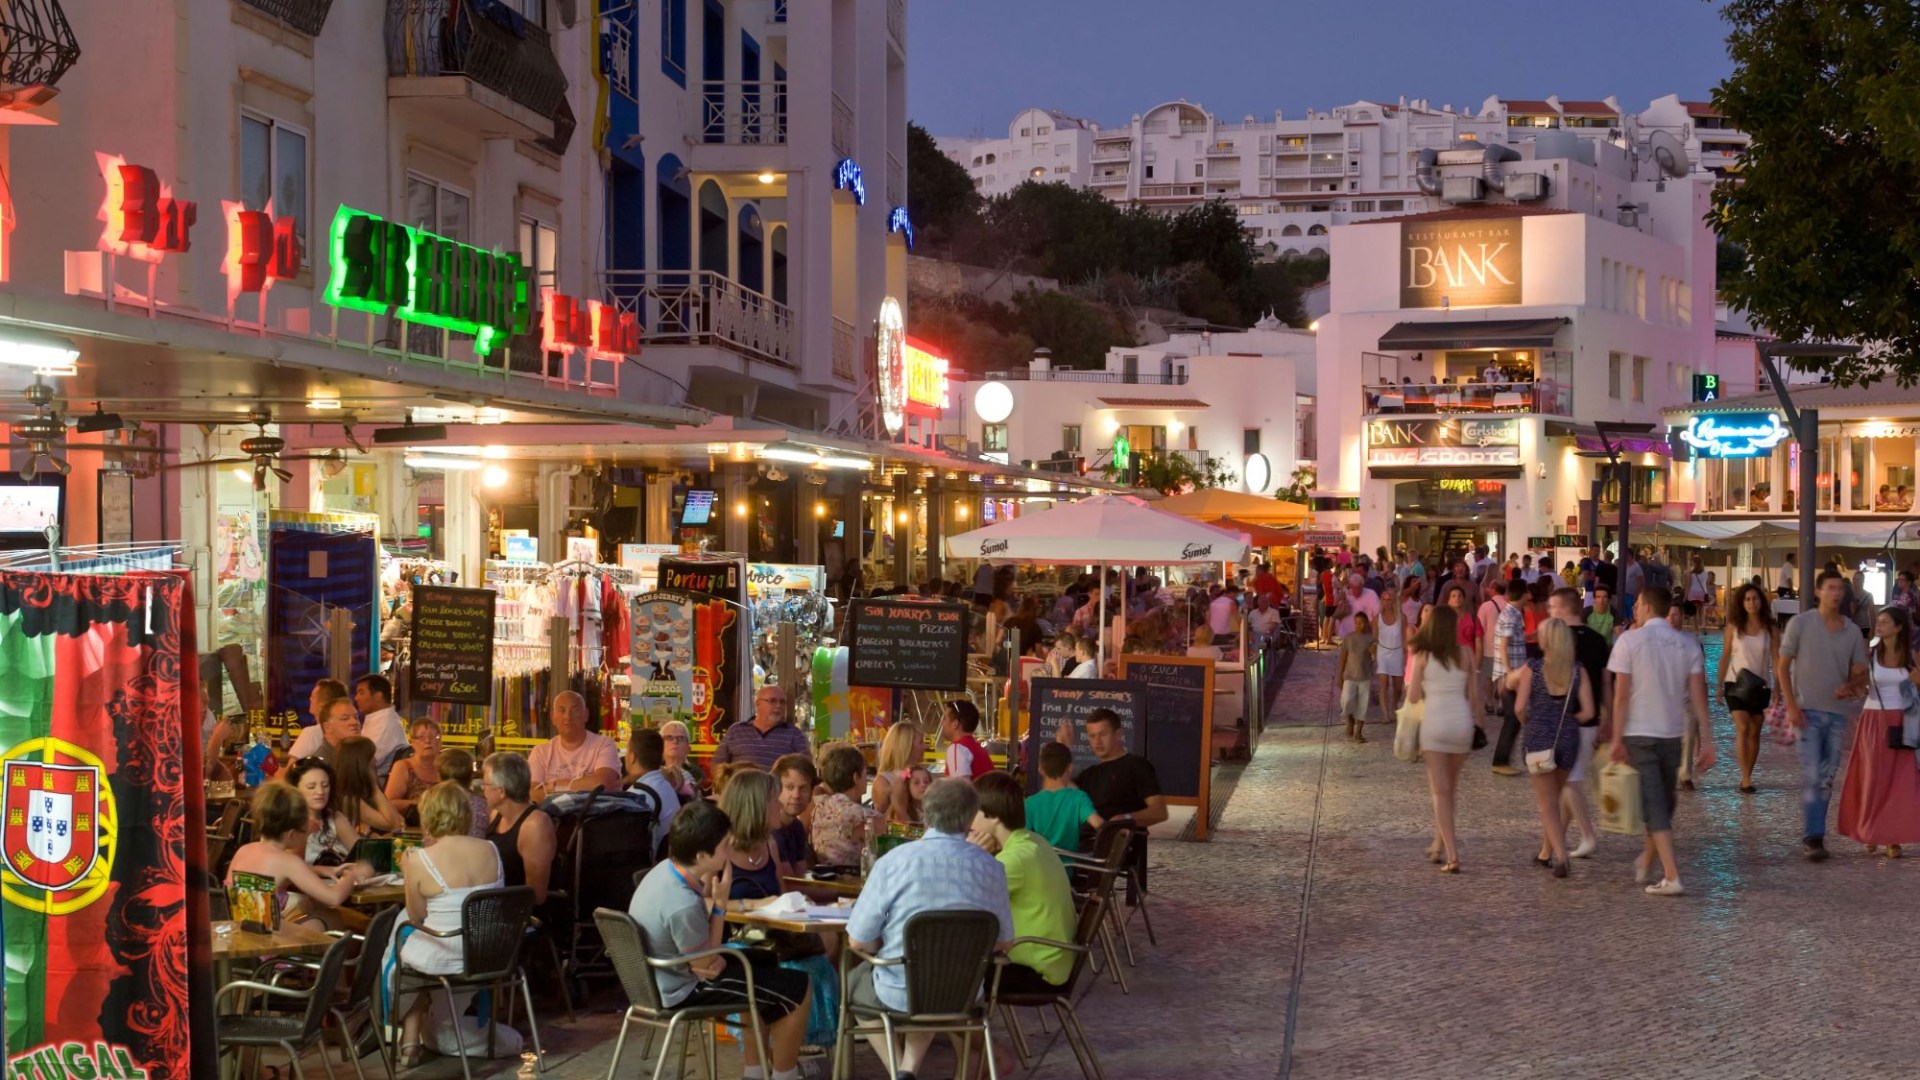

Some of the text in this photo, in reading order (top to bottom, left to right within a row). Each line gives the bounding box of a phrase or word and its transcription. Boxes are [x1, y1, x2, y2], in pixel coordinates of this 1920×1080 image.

[1408, 228, 1510, 241] RESTAURANT BAR
[1407, 242, 1516, 289] BANK
[1370, 423, 1425, 445] BANK
[1374, 451, 1515, 465] LIVE SPORTS
[980, 540, 1009, 556] Sumol
[1181, 544, 1212, 560] Sumol
[856, 637, 950, 648] ENGLISH BREAKFAST
